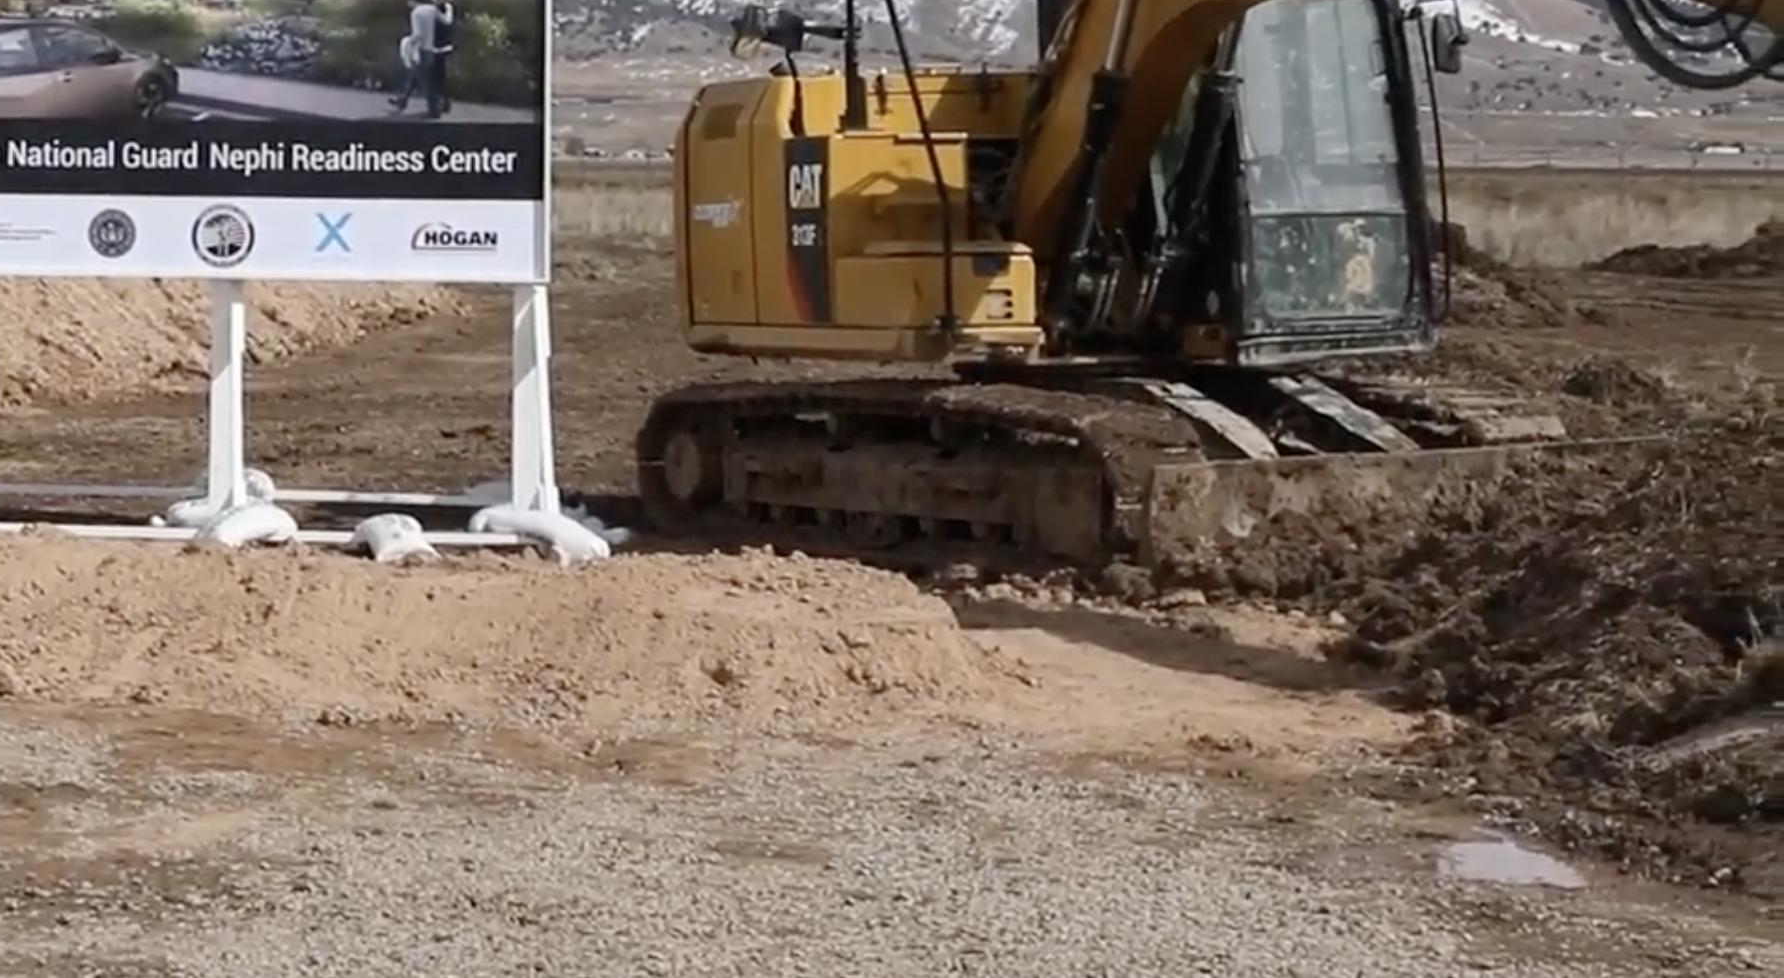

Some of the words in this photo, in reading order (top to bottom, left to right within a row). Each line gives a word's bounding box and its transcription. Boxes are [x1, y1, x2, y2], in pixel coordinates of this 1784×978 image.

[7, 139, 114, 168] National
[122, 141, 198, 169] Guard
[210, 143, 284, 176] Nephi
[292, 144, 424, 171] Readiness
[431, 145, 517, 172] Center
[789, 164, 823, 209] CAT
[423, 230, 498, 246] HOGAN
